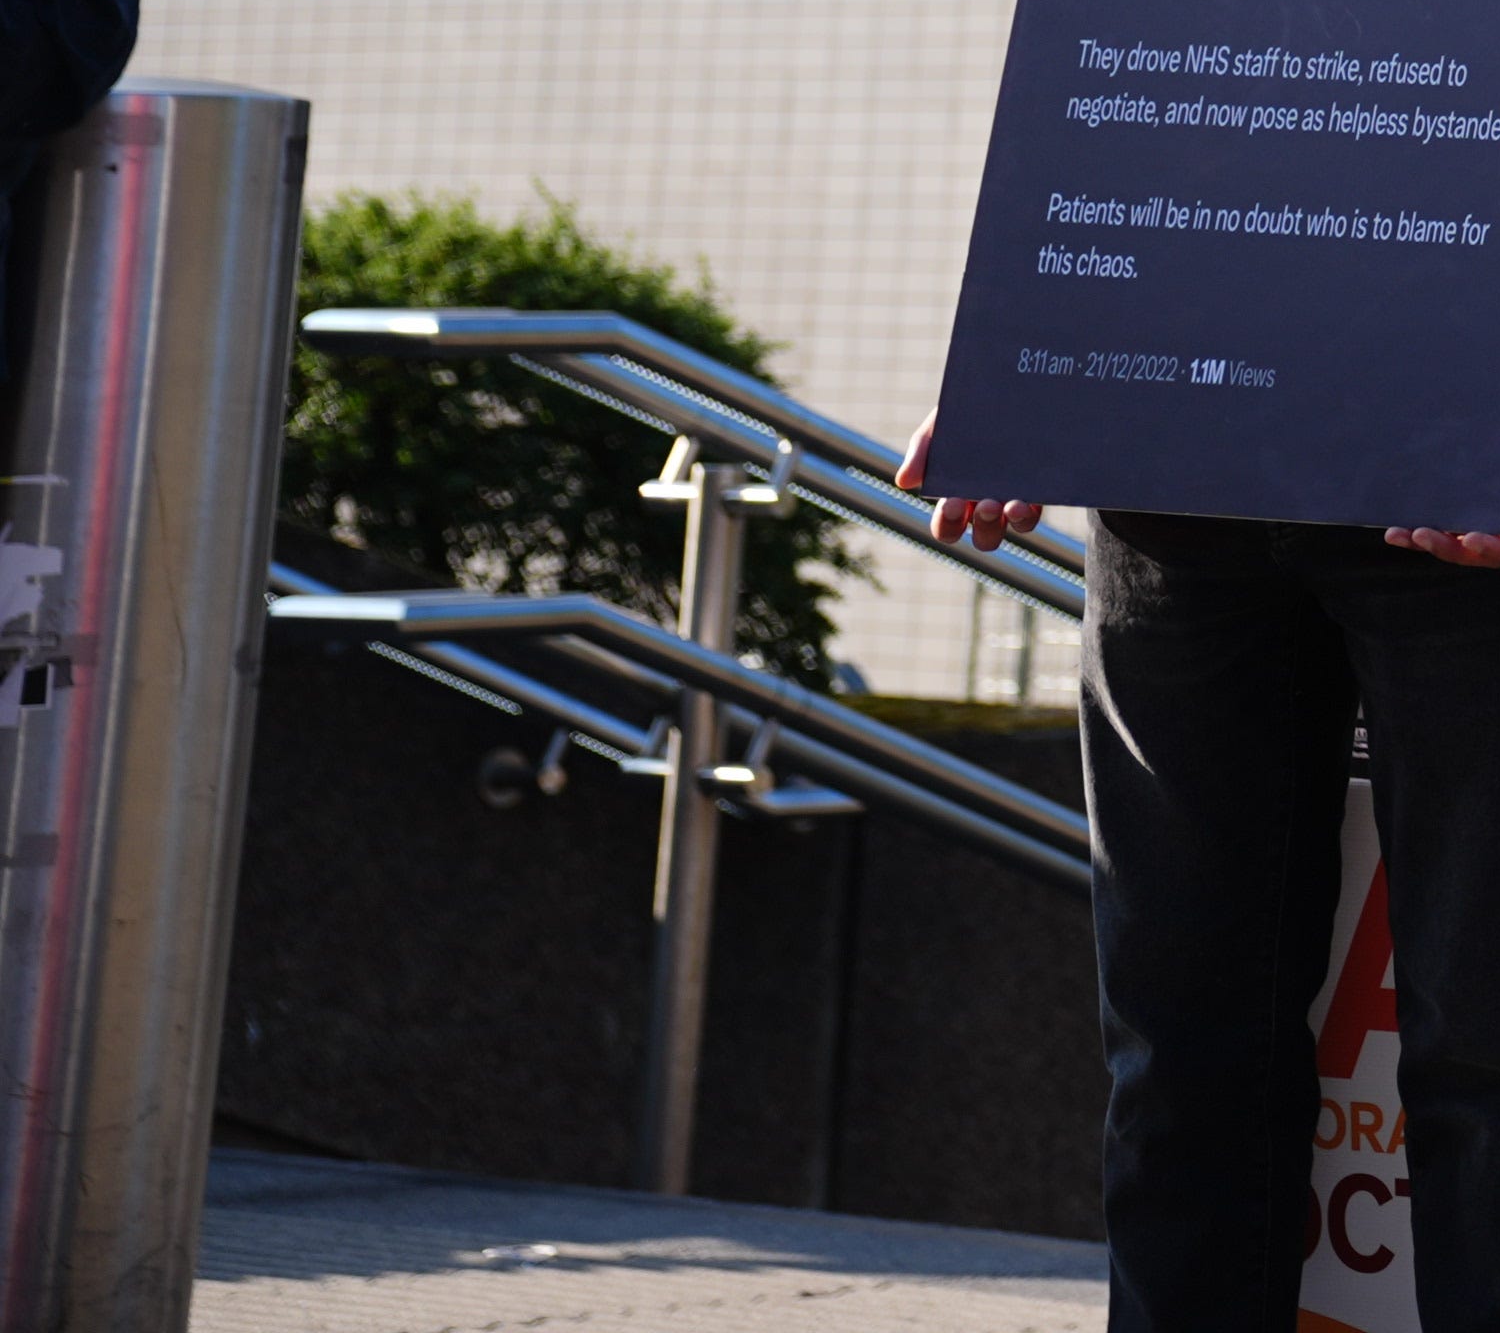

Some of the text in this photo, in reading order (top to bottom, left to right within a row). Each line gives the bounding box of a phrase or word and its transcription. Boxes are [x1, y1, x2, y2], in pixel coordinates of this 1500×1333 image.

[1079, 39, 1468, 87] They drove NHS staff to strike, refused to
[1066, 92, 1159, 128] negotiate,
[1164, 95, 1204, 126] and
[1205, 103, 1249, 127] now
[1249, 106, 1298, 135] pose
[1301, 108, 1325, 132] as
[1328, 101, 1409, 141] helpless
[1046, 192, 1491, 246] Patients will be in no doubt who is to blame for
[1037, 243, 1138, 279] this chaos.
[1083, 351, 1179, 382] 21/12/2022
[1189, 358, 1227, 386] 1.1M
[1229, 360, 1276, 388] Views
